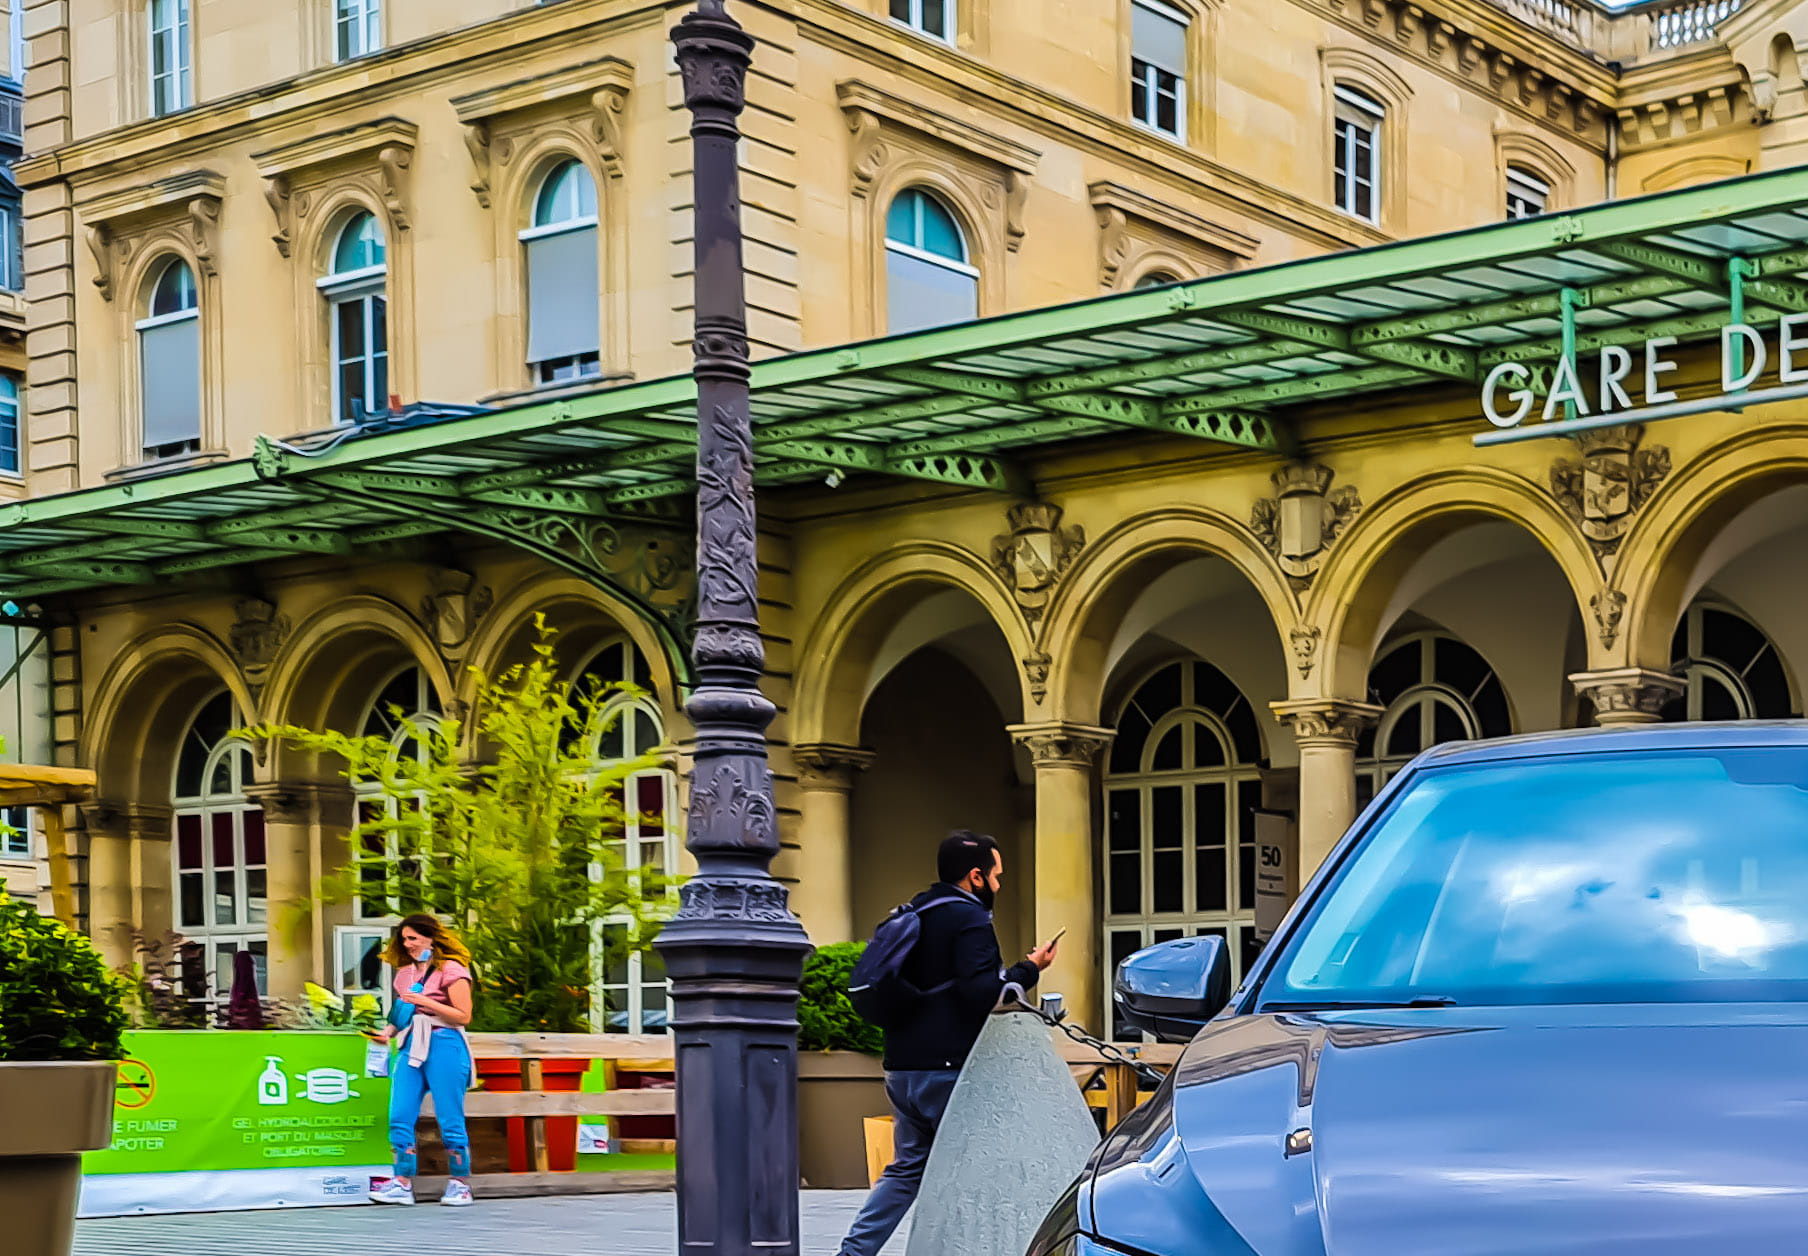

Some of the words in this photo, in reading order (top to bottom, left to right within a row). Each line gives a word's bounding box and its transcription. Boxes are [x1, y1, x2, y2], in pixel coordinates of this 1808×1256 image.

[1481, 336, 1678, 428] GARE
[1261, 845, 1281, 867] 50
[127, 1120, 177, 1133] FUMER
[232, 1117, 254, 1129] GEL
[243, 1132, 256, 1143] ET
[260, 1132, 289, 1142] PORT
[293, 1131, 310, 1142] DU
